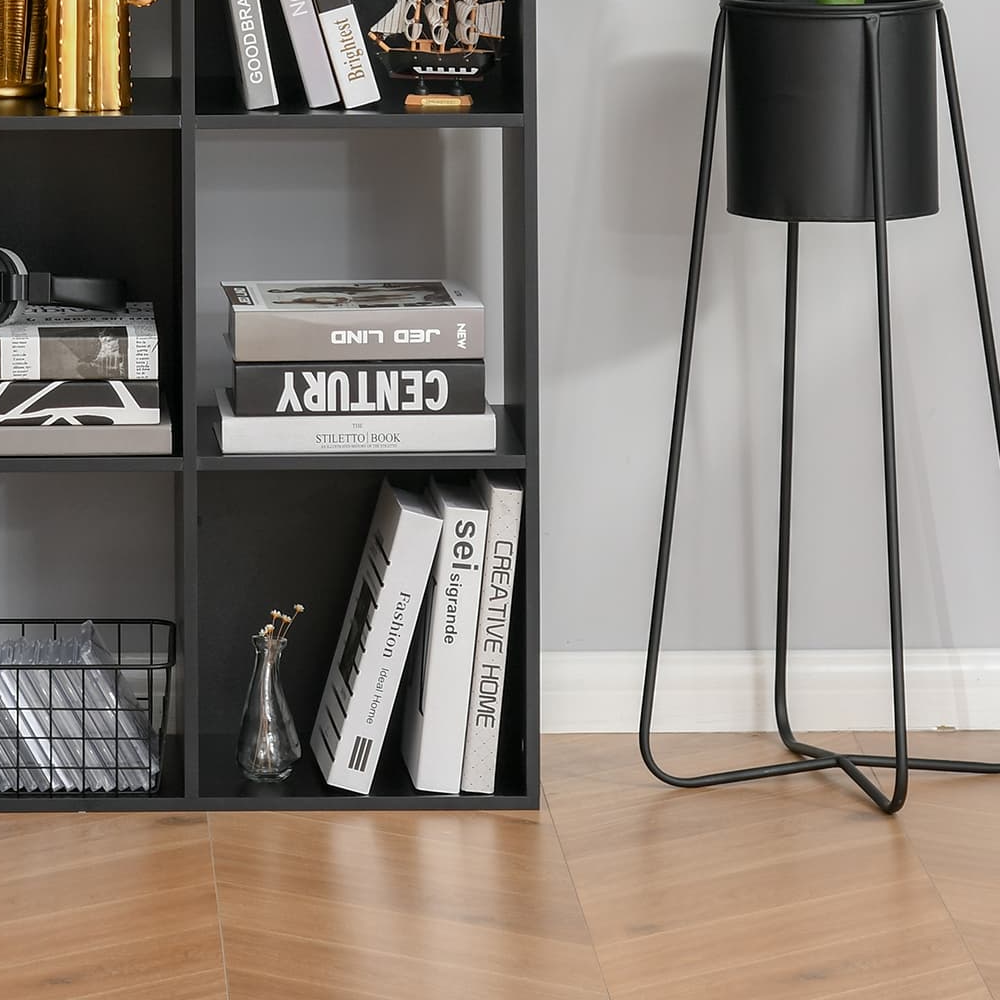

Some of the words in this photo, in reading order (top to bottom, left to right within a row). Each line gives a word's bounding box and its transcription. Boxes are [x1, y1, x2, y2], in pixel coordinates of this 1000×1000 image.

[333, 17, 366, 82] Brightest
[330, 329, 383, 344] LIND
[393, 329, 441, 343] JED
[456, 323, 467, 350] NEW
[275, 369, 449, 413] CENTURY
[315, 433, 365, 443] STILETTO
[371, 433, 401, 443] BOOK
[452, 519, 479, 571] sei
[444, 572, 463, 645] sigrande
[483, 540, 513, 653] CREATIVE
[383, 591, 412, 658] Fashion
[375, 667, 390, 693] Ideal
[475, 663, 502, 729] HOME
[366, 694, 383, 725] Home
